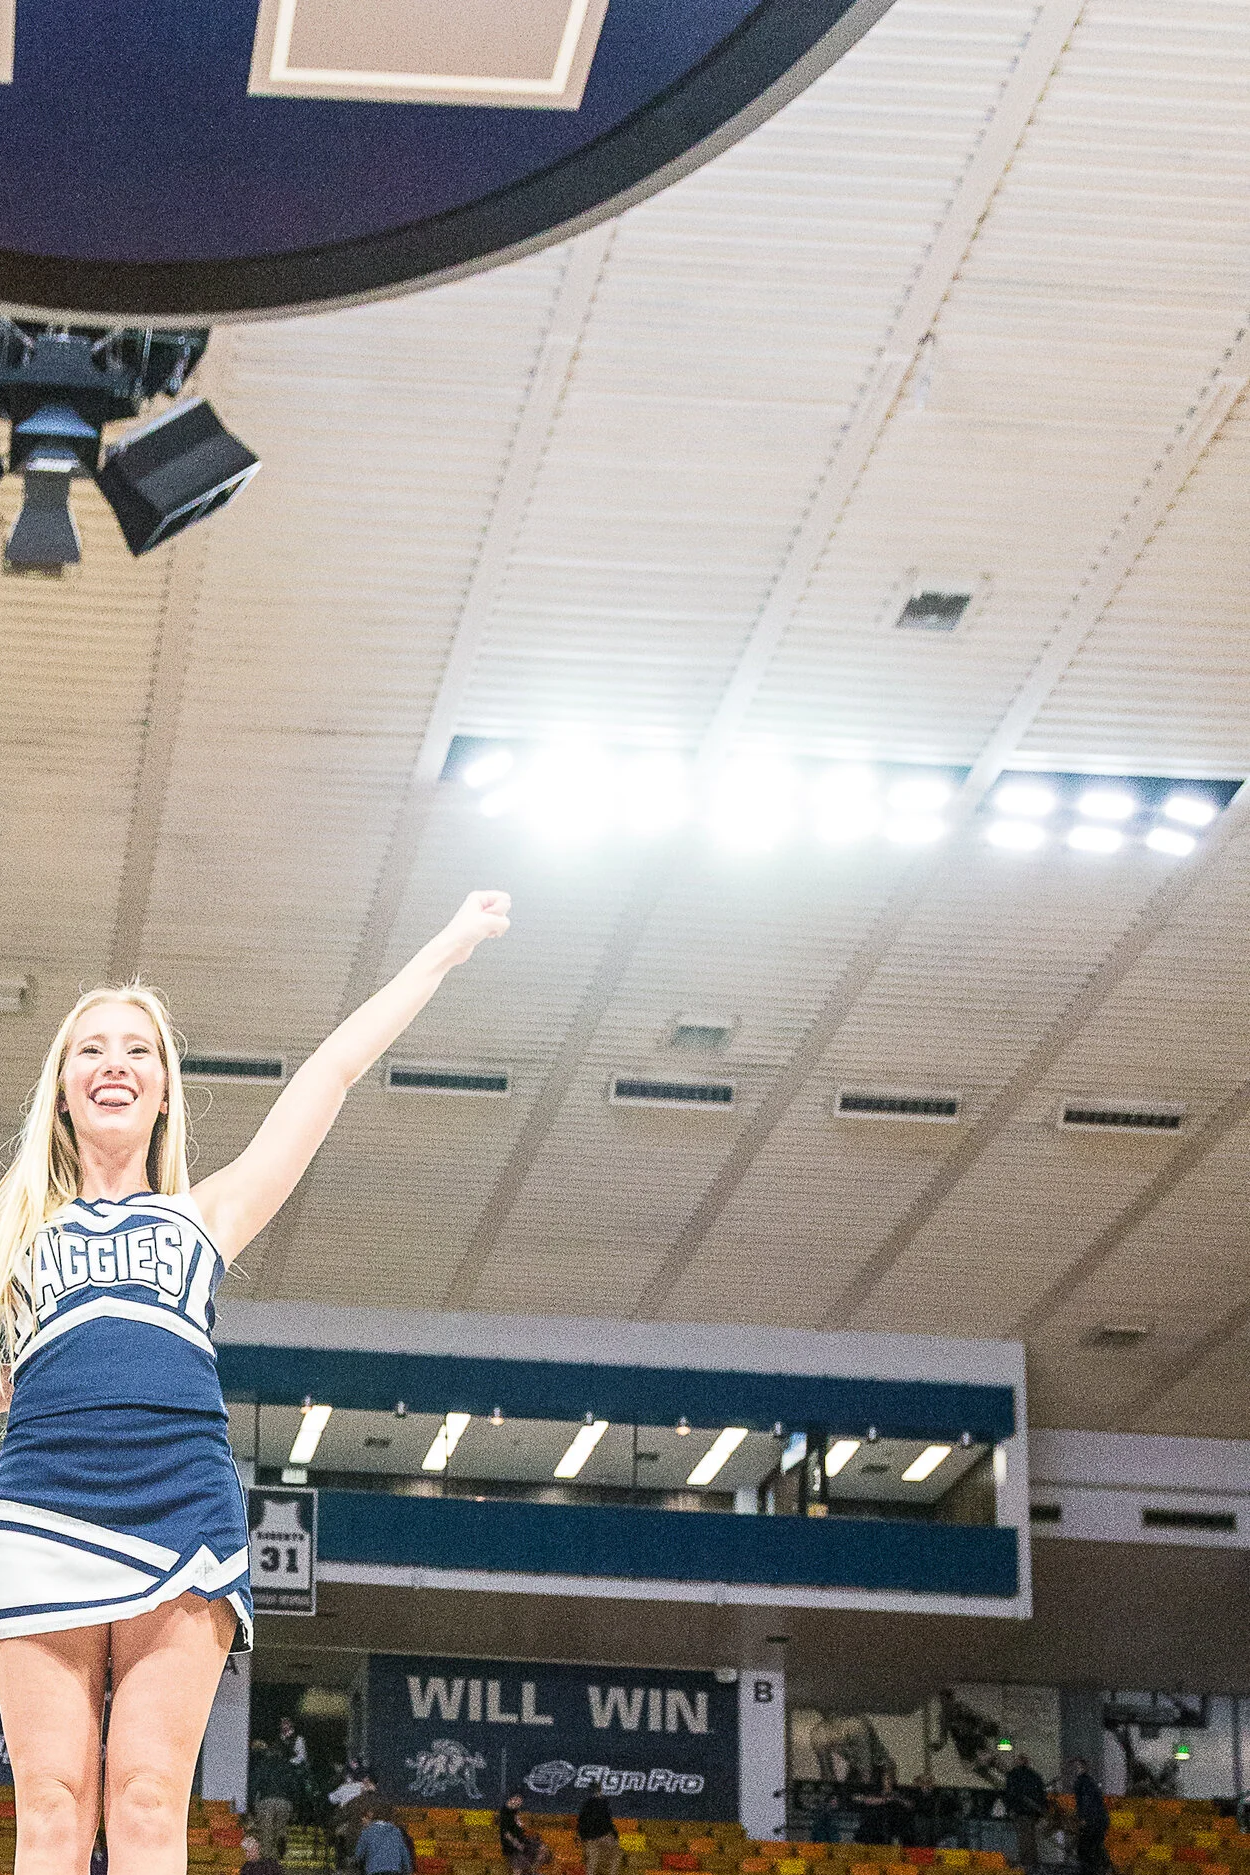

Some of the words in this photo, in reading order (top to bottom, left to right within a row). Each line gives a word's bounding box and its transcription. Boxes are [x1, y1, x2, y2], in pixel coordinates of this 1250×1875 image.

[32, 1224, 183, 1312] AGGIES
[261, 1547, 298, 1573] 31
[406, 1675, 553, 1726] WILL
[587, 1685, 709, 1734] WIN
[754, 1681, 775, 1703] B
